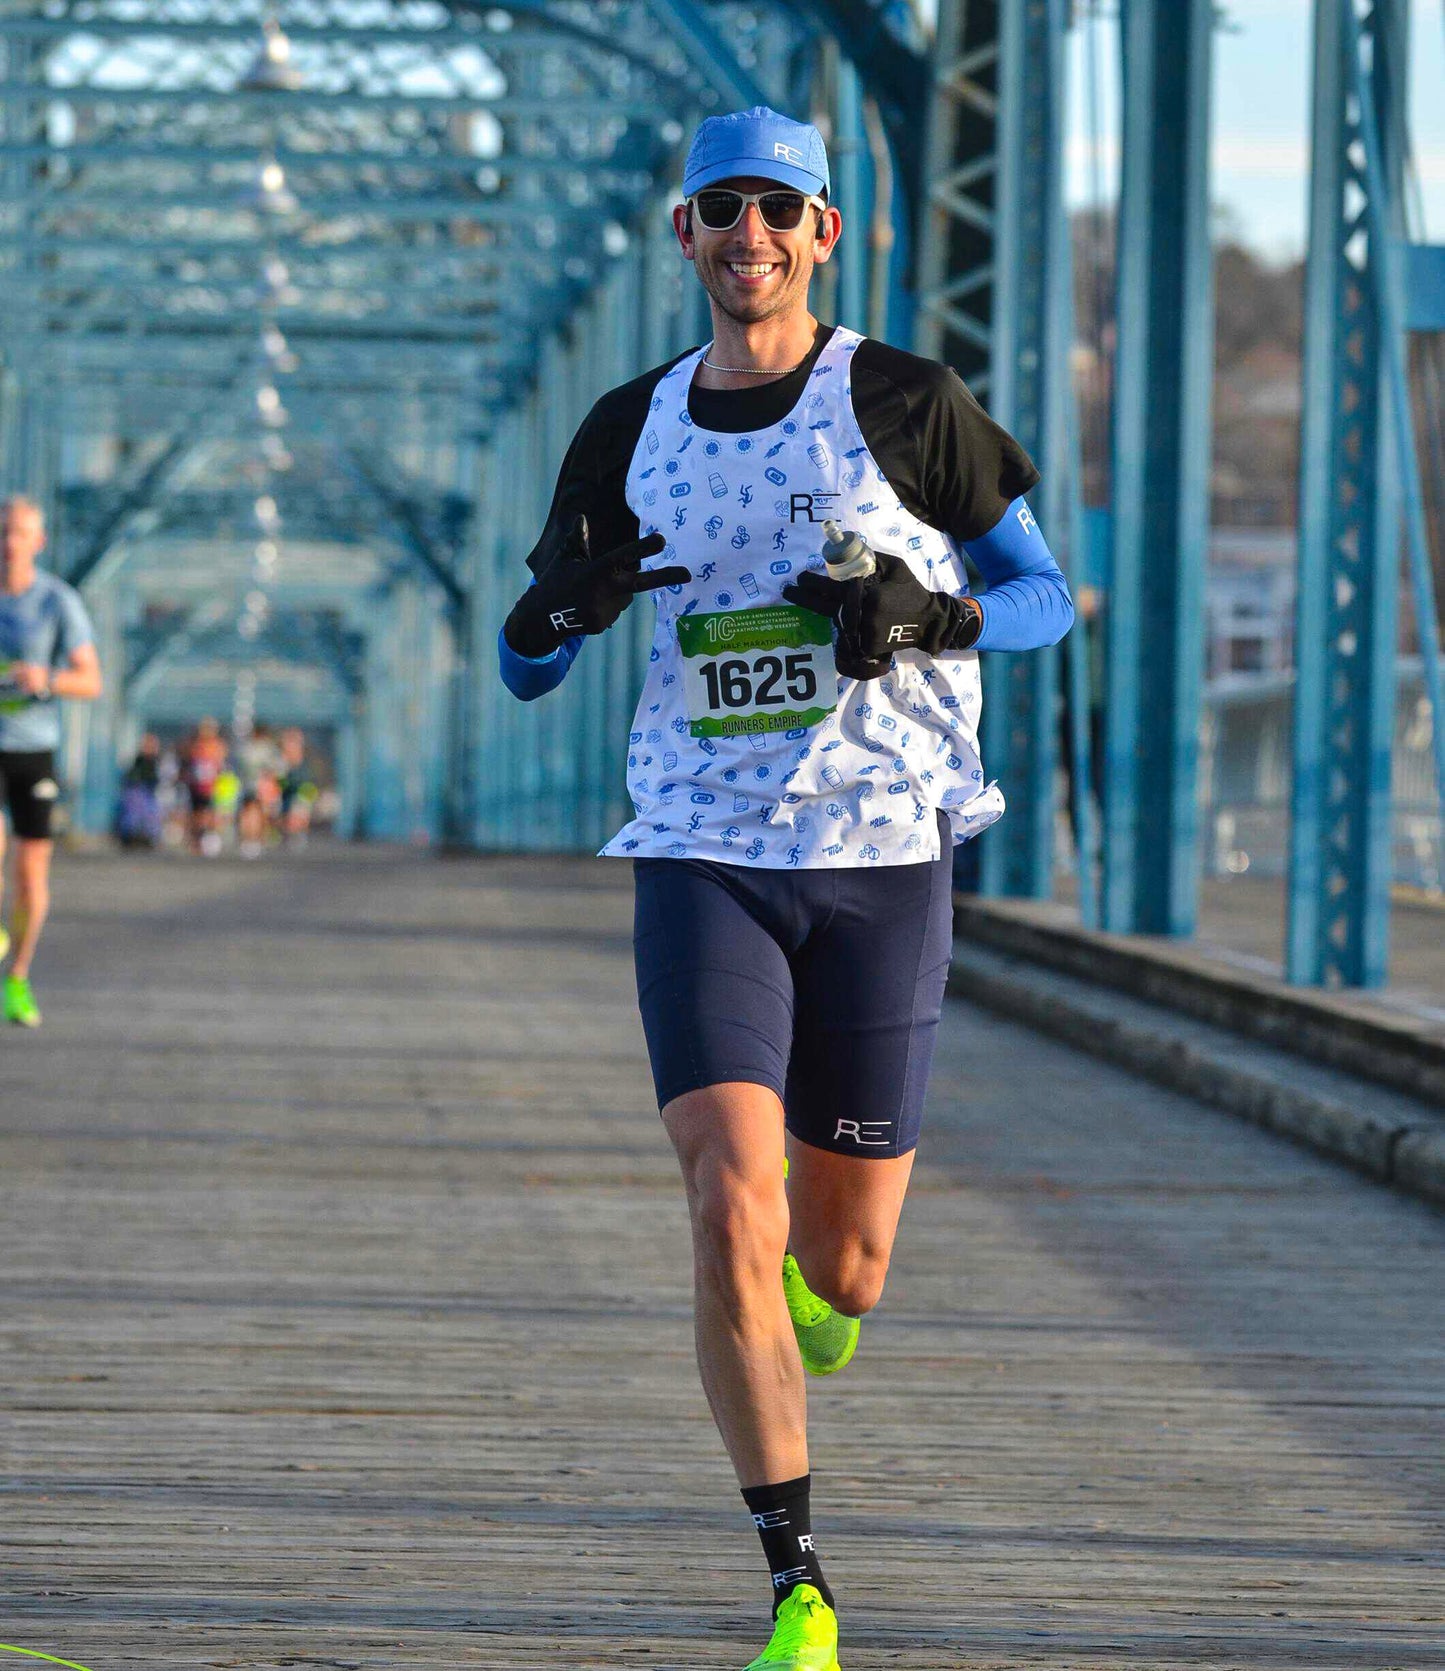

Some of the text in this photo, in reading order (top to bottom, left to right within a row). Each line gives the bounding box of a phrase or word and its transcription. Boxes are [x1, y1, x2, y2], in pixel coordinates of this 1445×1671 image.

[774, 142, 804, 167] RE
[790, 493, 842, 523] RE
[549, 608, 583, 631] RE
[704, 616, 735, 642] 10
[757, 616, 799, 625] CHATTANOOGA
[743, 638, 787, 648] MARATHON
[887, 624, 919, 643] RE
[699, 653, 817, 710] 1625
[722, 714, 802, 734] RUNNERS EMPIRE
[833, 1118, 892, 1145] RE
